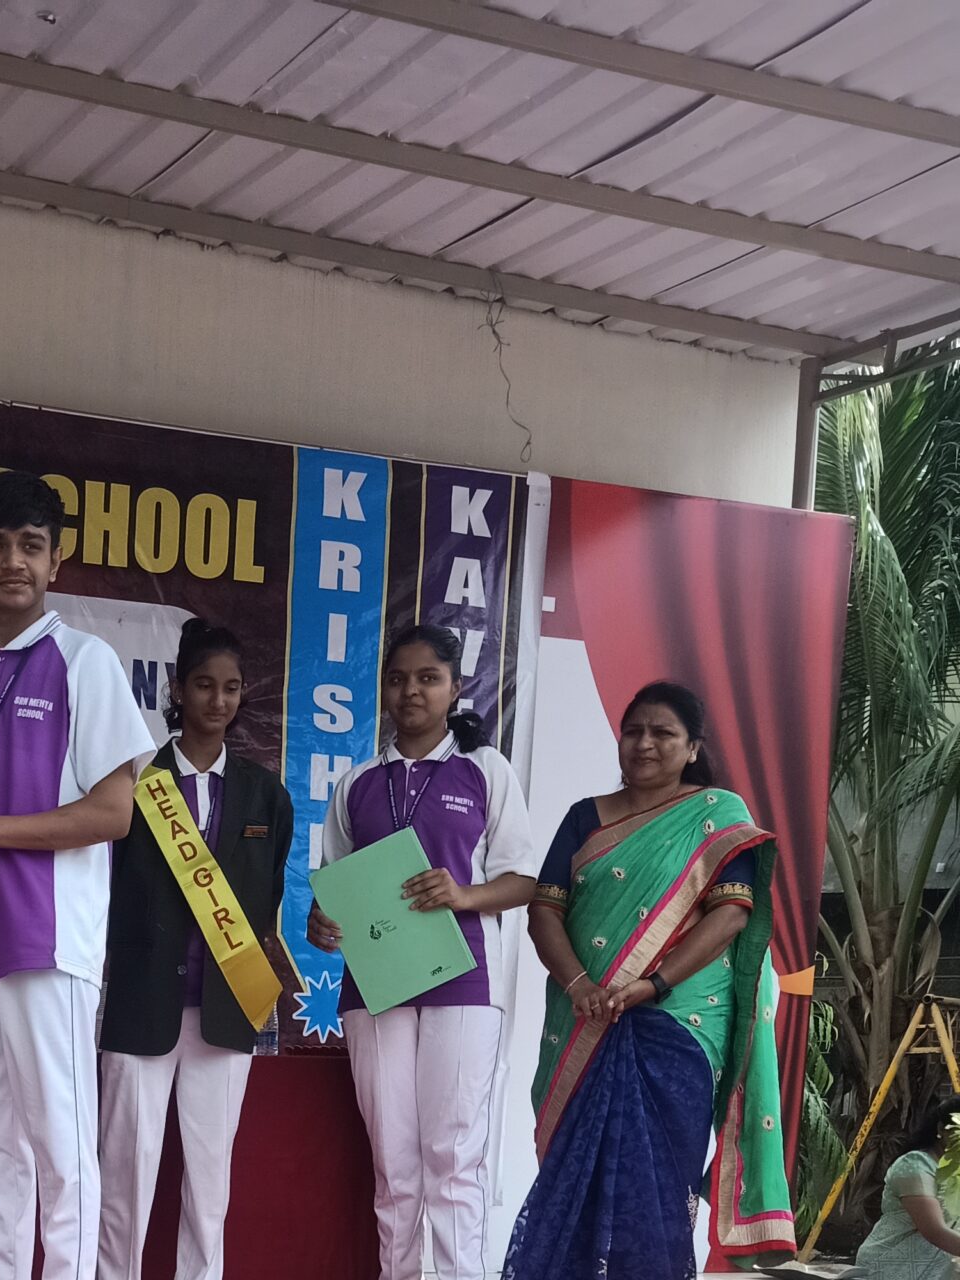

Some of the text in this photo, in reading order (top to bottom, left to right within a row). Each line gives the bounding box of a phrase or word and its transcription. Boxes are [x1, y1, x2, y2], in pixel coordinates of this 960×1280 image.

[444, 485, 493, 713] KAV
[28, 697, 54, 711] MEHTA
[17, 708, 44, 720] SCHOOL
[445, 803, 469, 814] SCHOOL
[146, 779, 243, 951] HEAD GIRL
